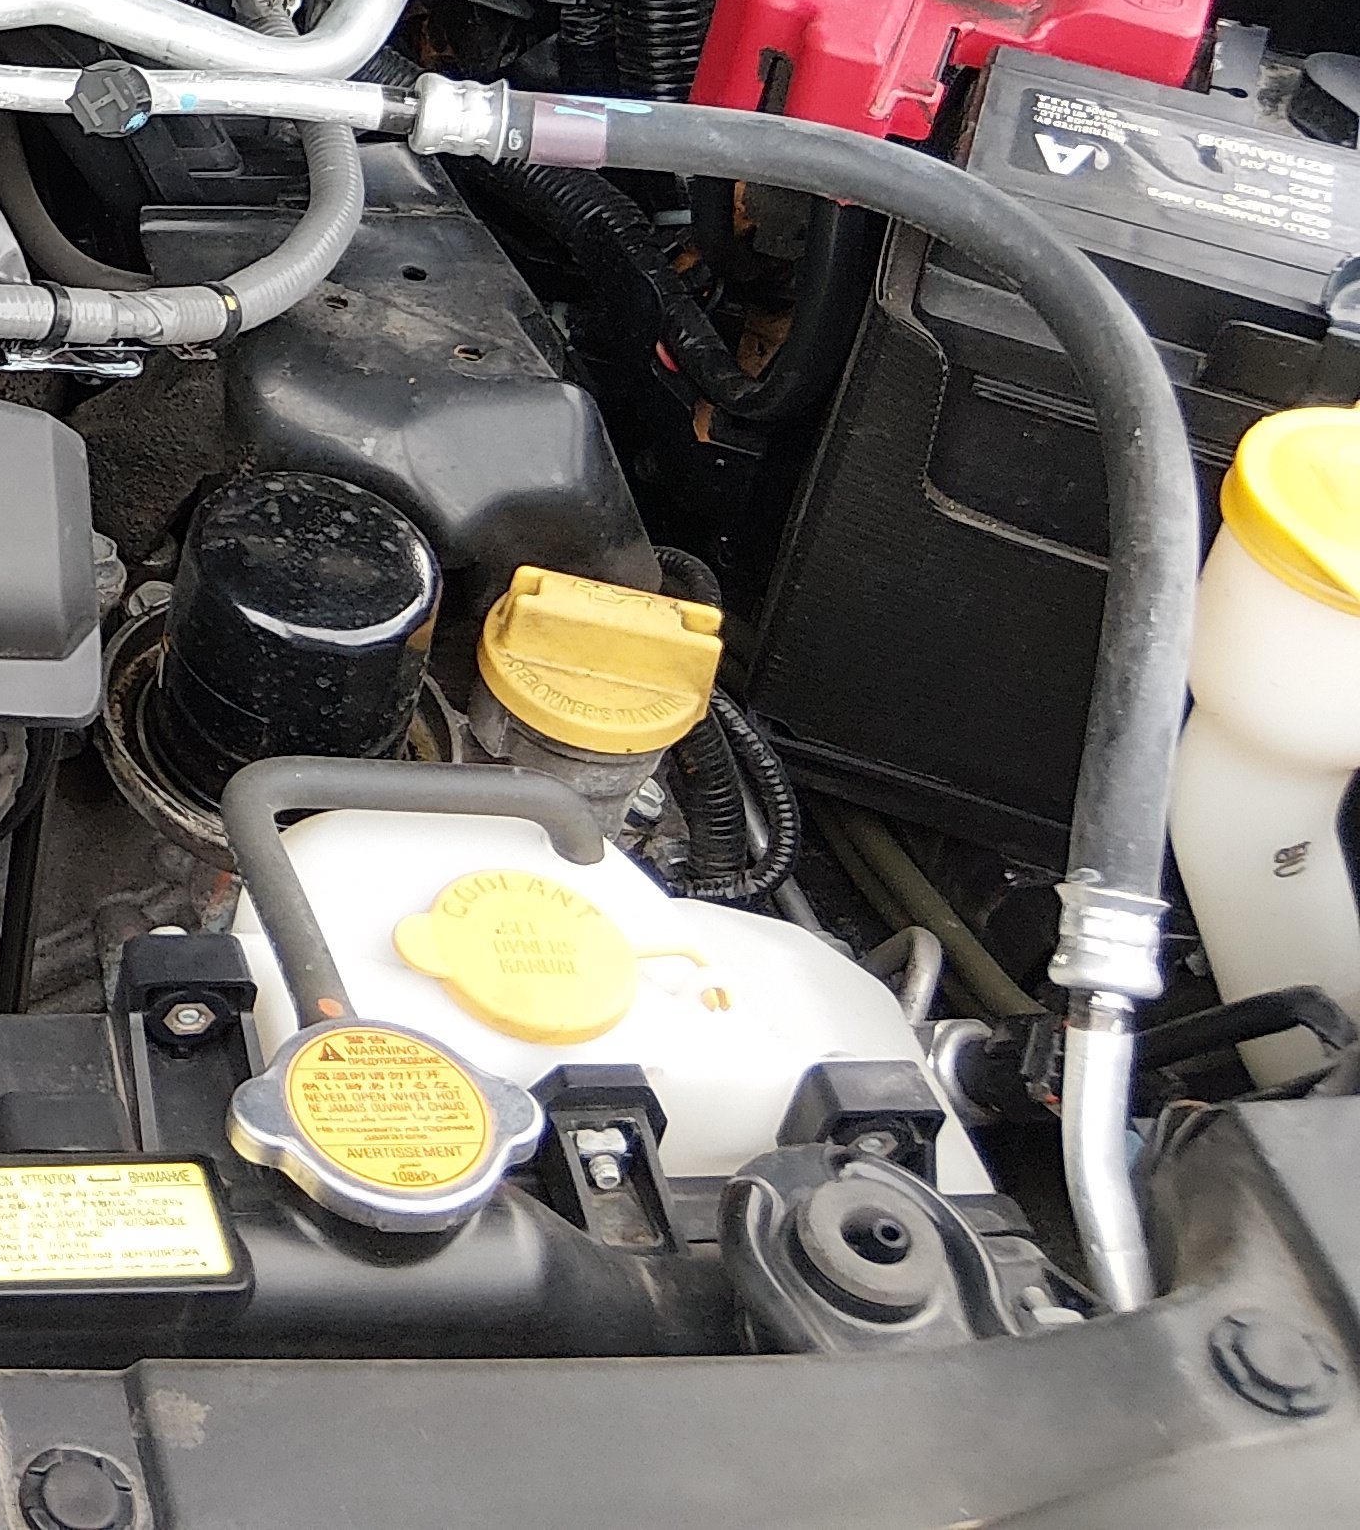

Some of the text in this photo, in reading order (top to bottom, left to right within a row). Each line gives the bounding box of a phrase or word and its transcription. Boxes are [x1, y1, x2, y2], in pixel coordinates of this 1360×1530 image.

[1222, 193, 1289, 217] AMPS
[1282, 222, 1331, 239] COLD
[506, 657, 538, 687] SEE
[615, 695, 688, 725] MANUAL
[441, 873, 602, 919] COOLANT
[343, 1045, 420, 1056] WARNING
[303, 1092, 347, 1103] NEVER
[351, 1092, 387, 1102] OPEN
[390, 1091, 432, 1102] WHEN
[307, 1103, 322, 1113] NE
[328, 1102, 367, 1113] JAMAIS
[370, 1102, 413, 1113] OUVRIR
[346, 1146, 464, 1159] AVERTISSEMENT
[20, 1173, 77, 1185] ATTENTION
[391, 1171, 438, 1183] 108kPa
